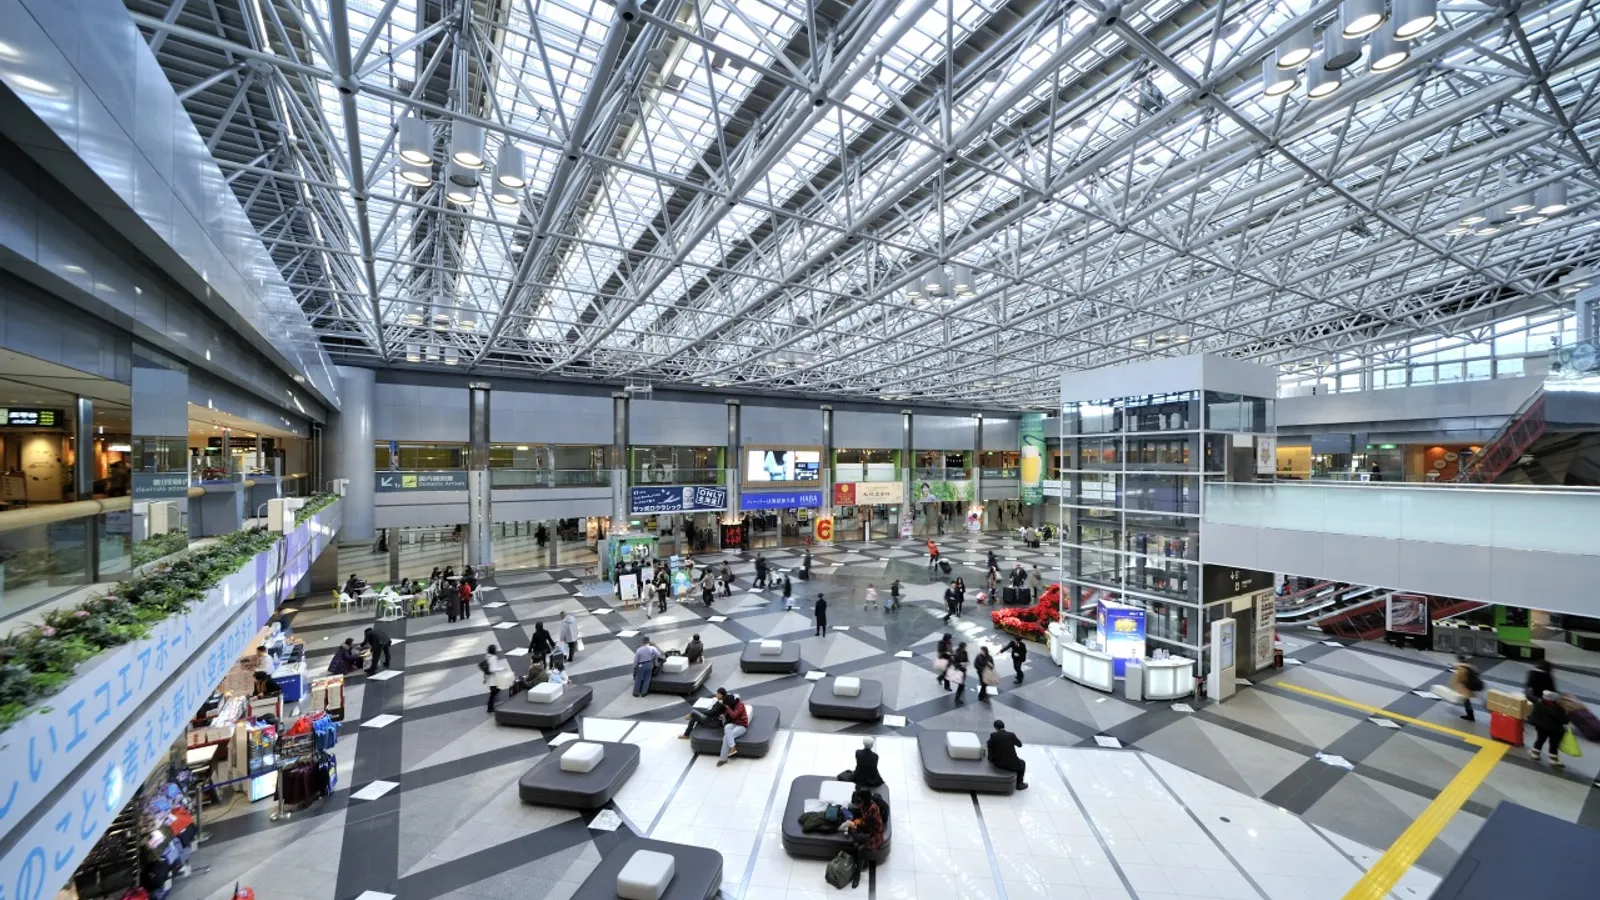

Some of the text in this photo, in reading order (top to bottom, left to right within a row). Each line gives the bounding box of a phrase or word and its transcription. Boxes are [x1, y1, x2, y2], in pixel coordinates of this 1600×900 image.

[699, 489, 723, 503] ONLY
[799, 494, 818, 503] HABA
[633, 504, 682, 512] サッポロクラシック
